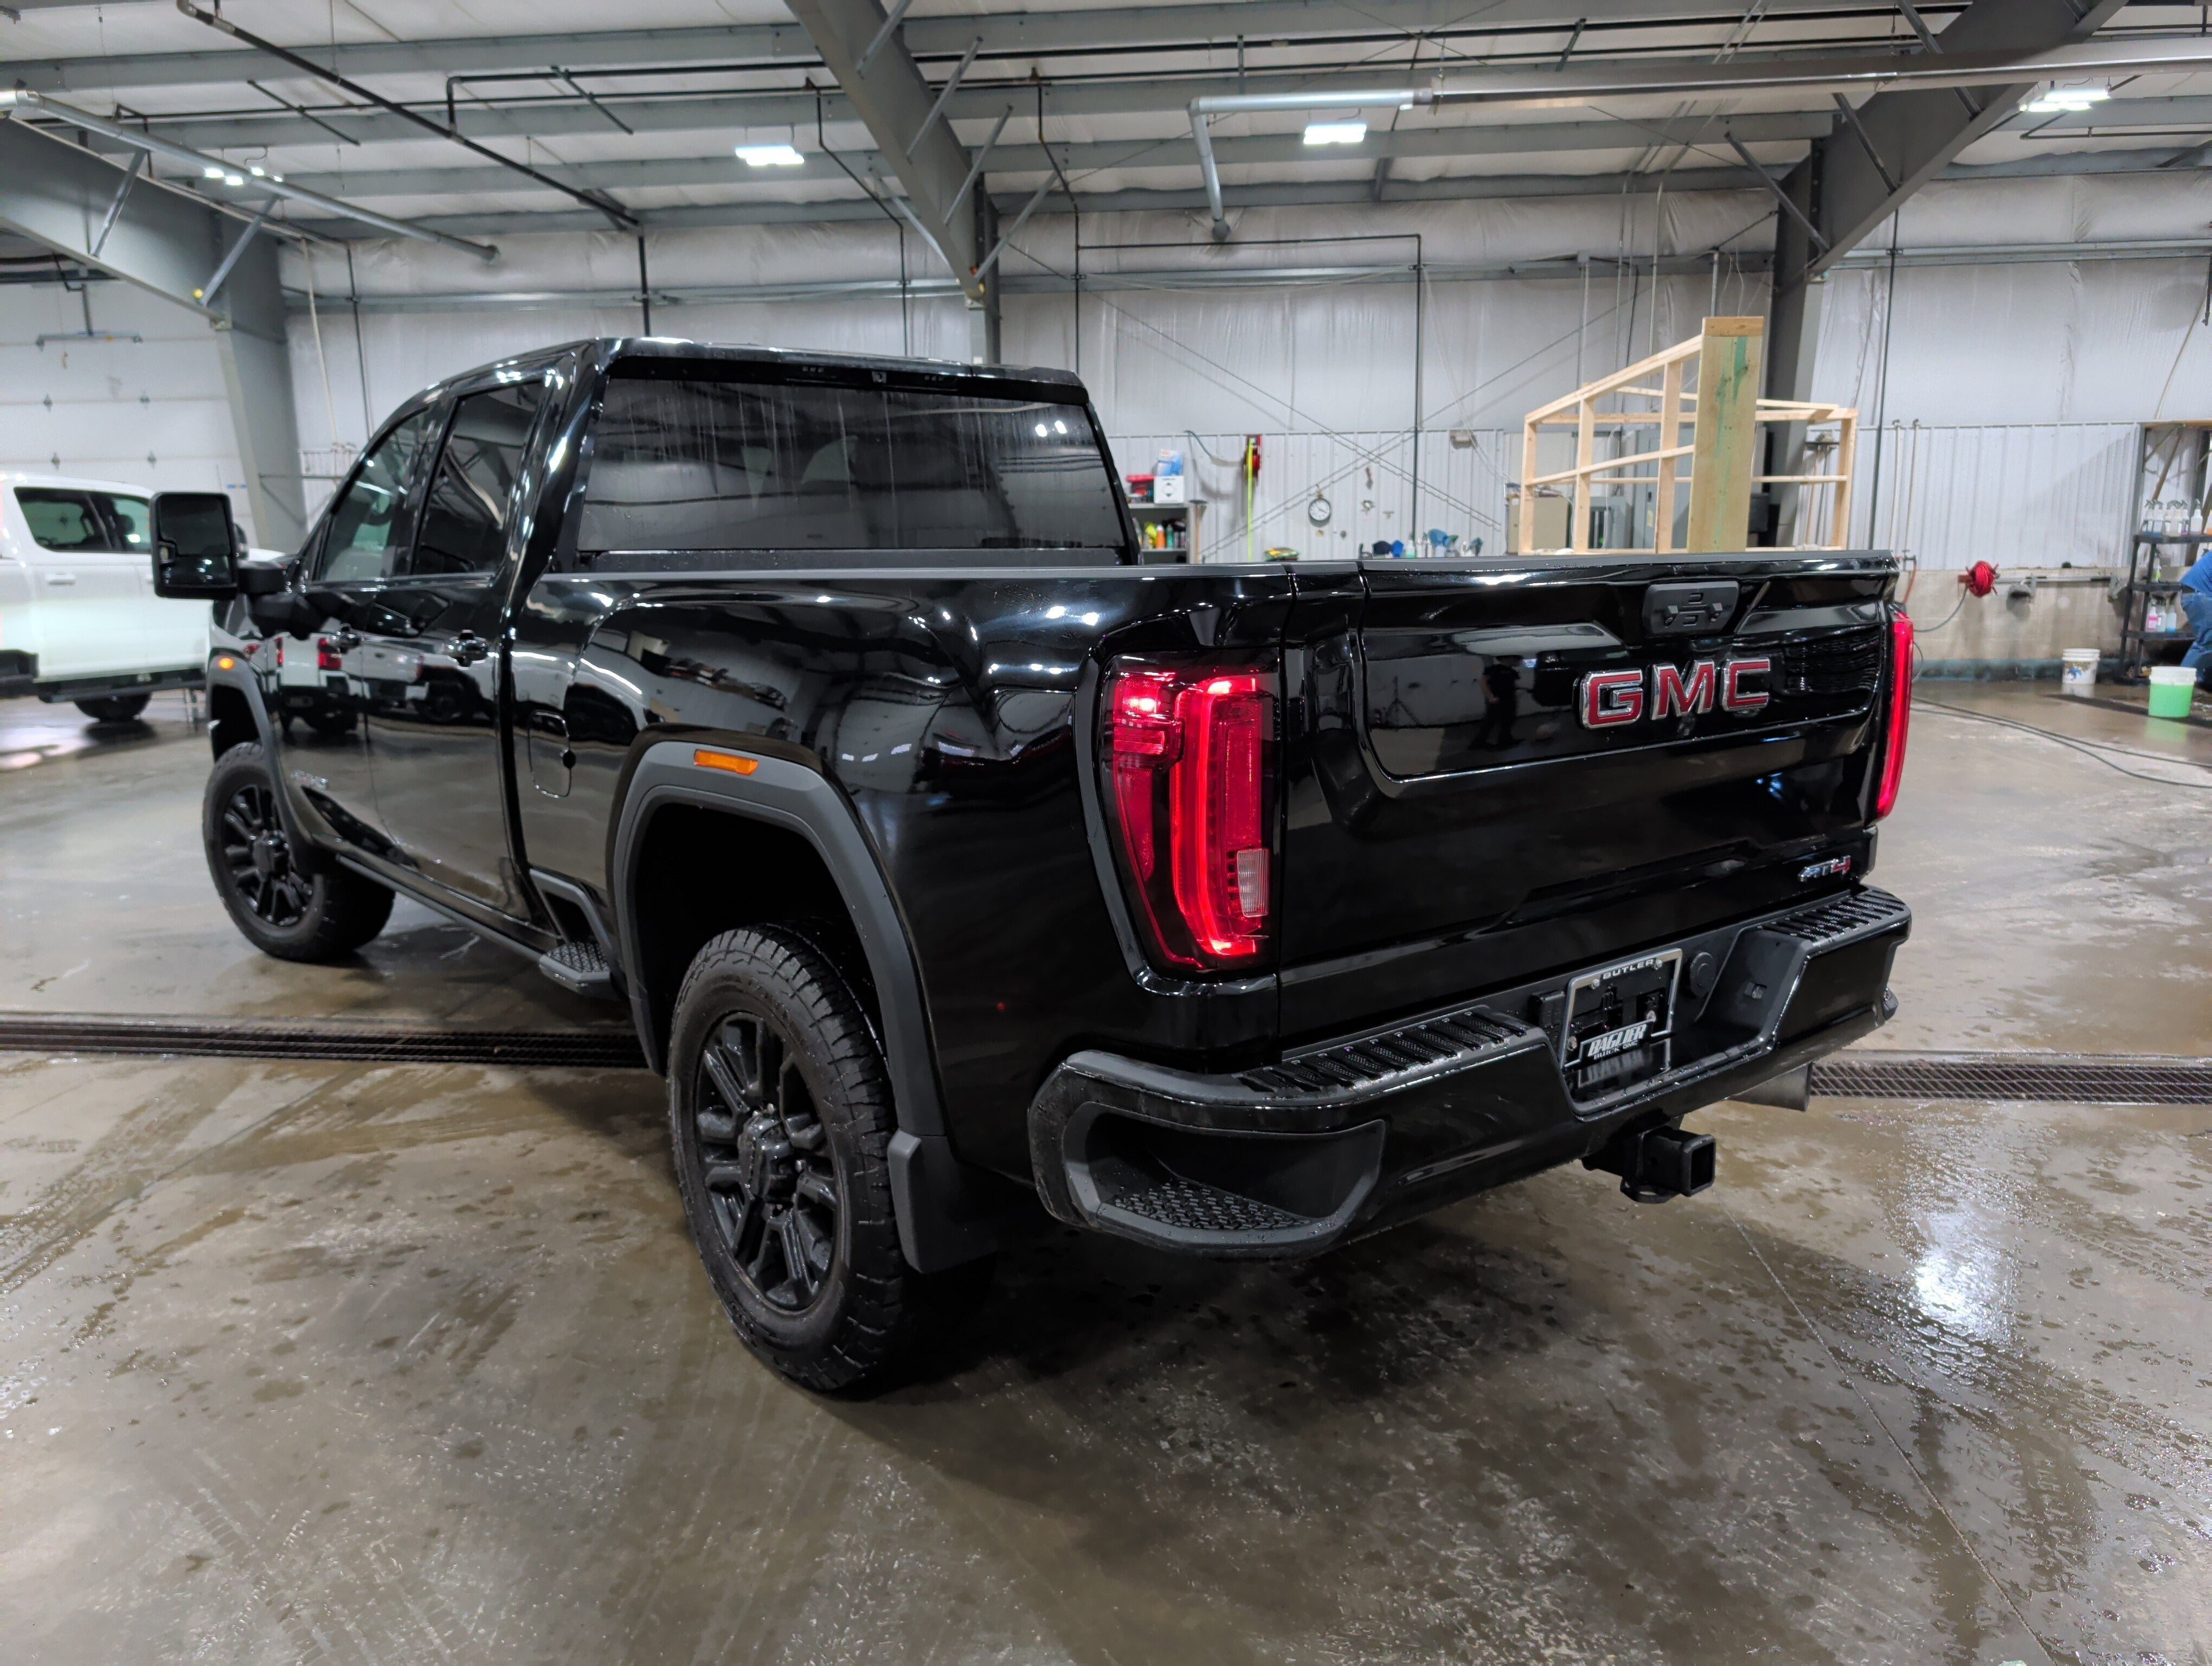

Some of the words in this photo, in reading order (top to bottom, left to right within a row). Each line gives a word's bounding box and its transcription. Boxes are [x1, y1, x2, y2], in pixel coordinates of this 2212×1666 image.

[1580, 658, 1770, 729] GMC
[1603, 959, 1654, 979] BUTLER
[1587, 1024, 1647, 1057] BAGLIER
[1594, 1046, 1621, 1060] BUICK
[1623, 1040, 1638, 1049] GMC
